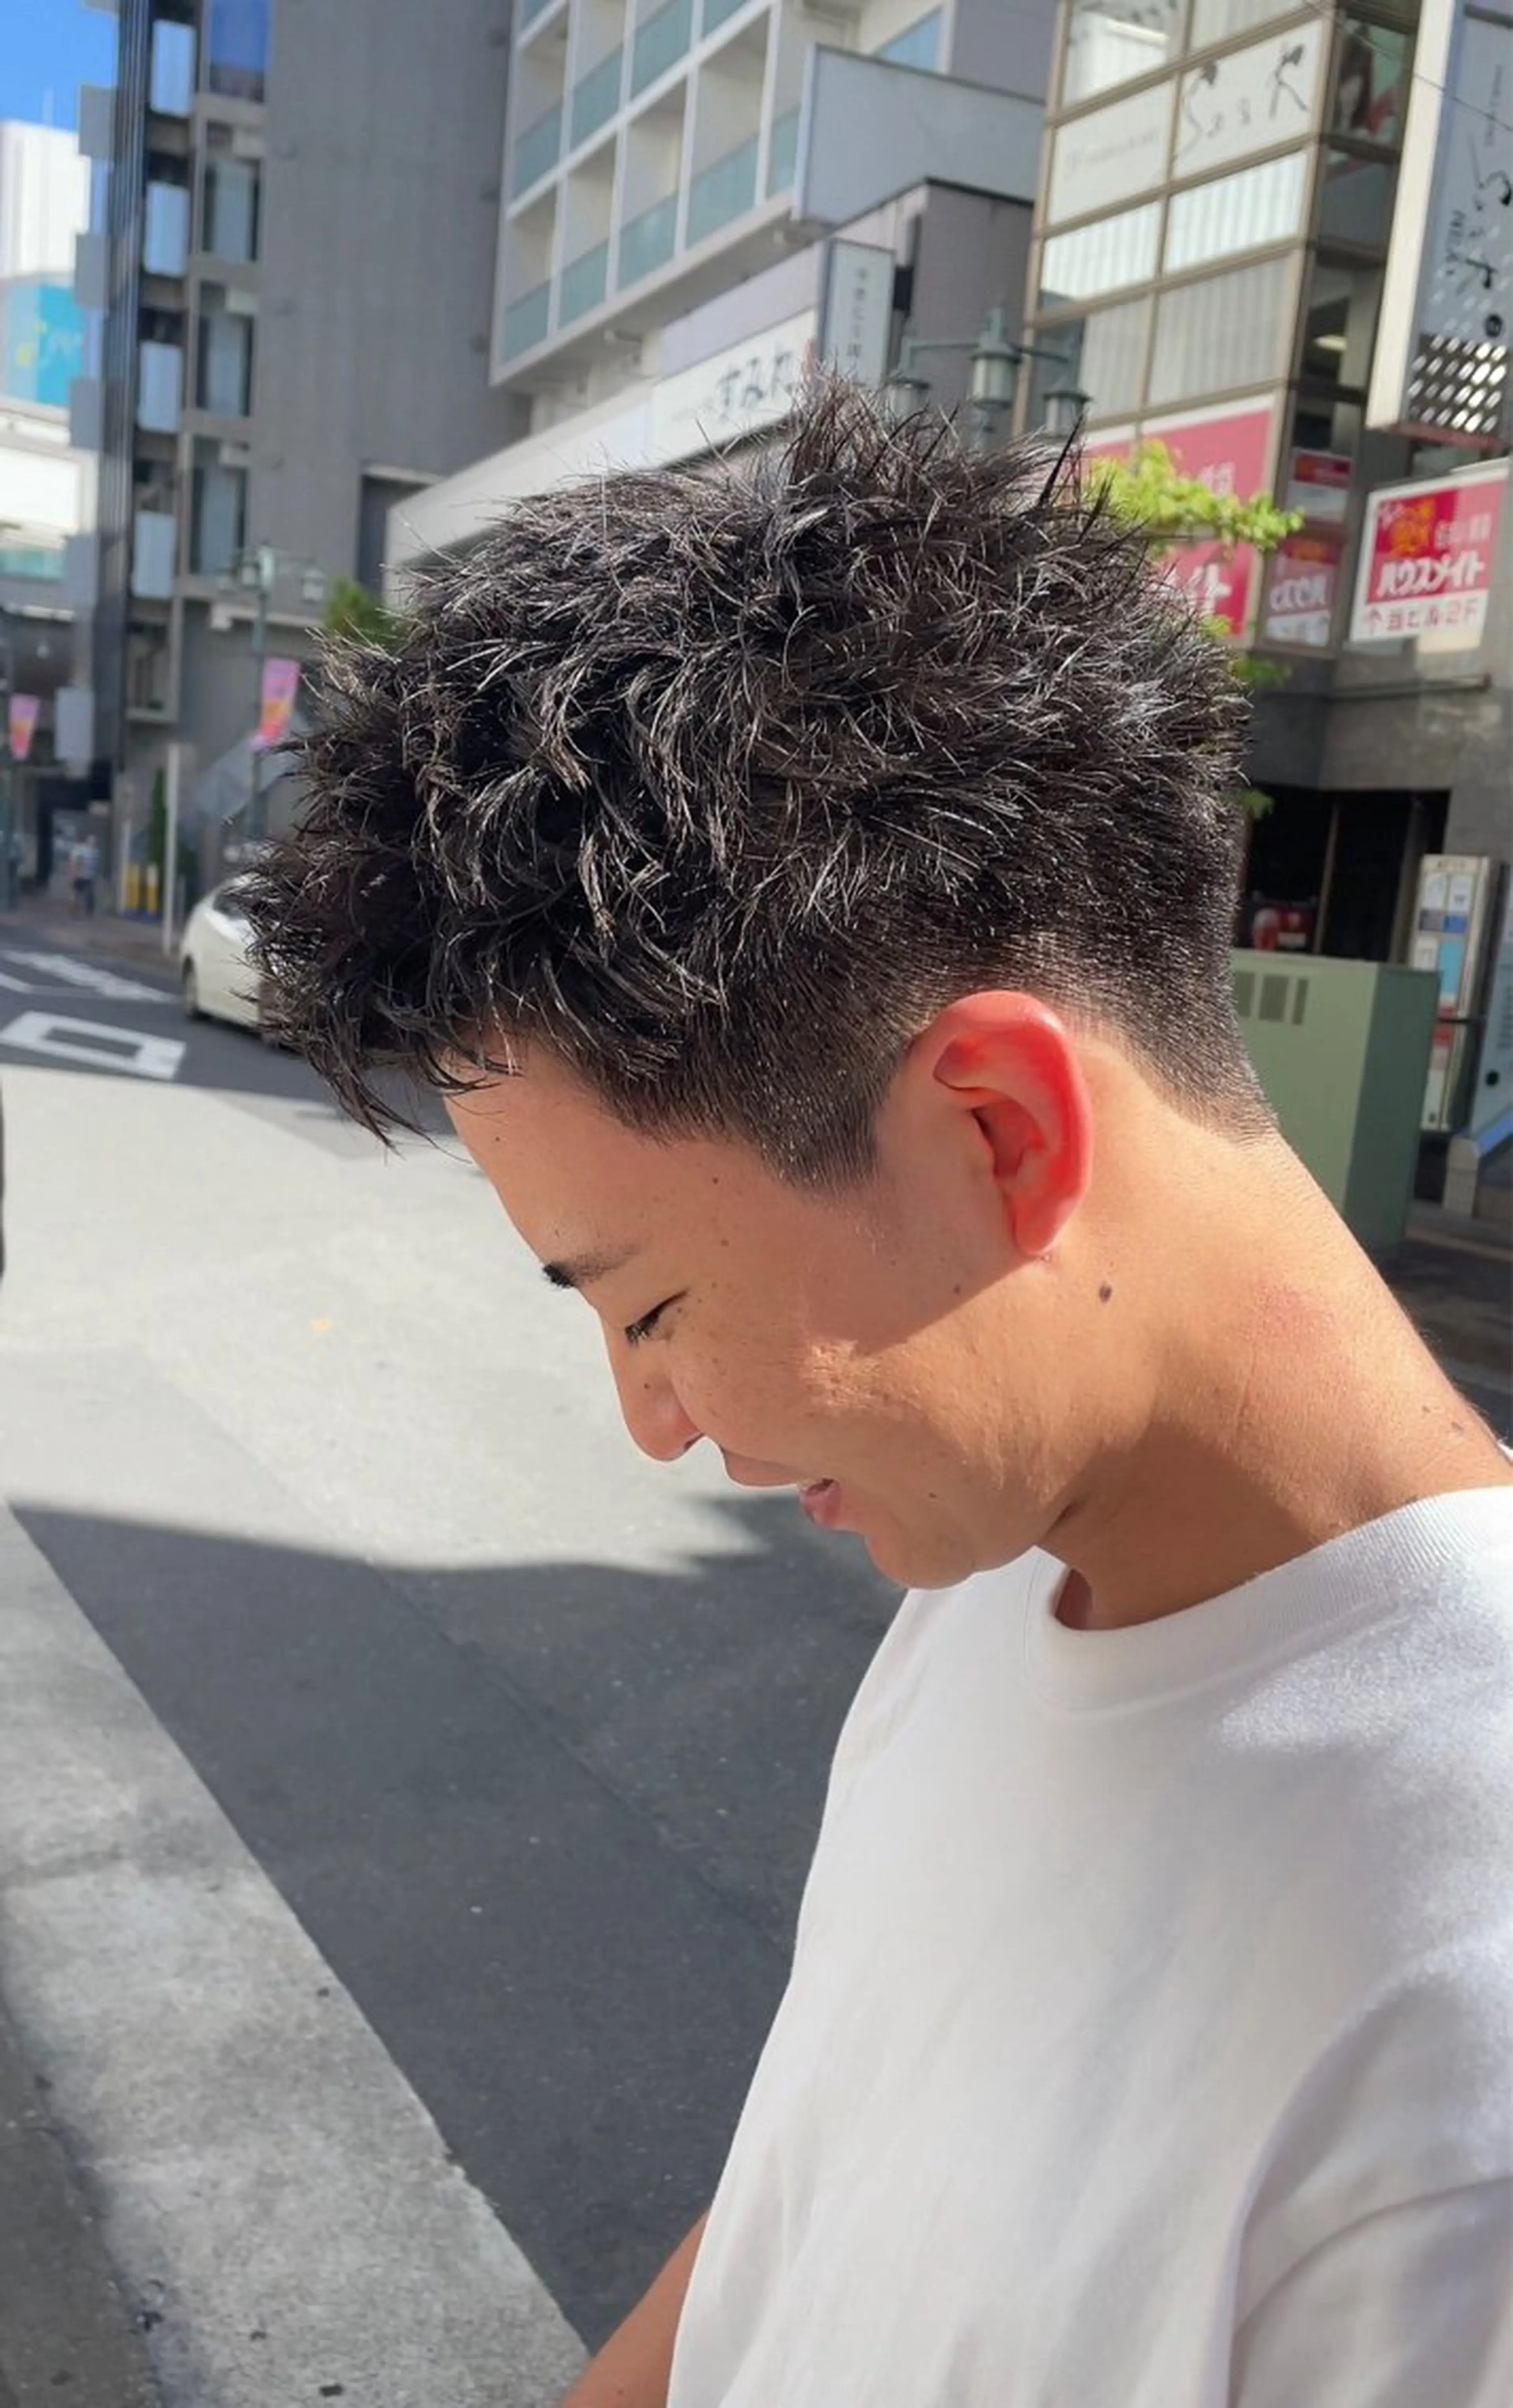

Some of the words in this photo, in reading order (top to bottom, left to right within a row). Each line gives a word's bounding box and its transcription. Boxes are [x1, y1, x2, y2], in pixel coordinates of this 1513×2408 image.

[1376, 550, 1485, 598] ハウスメイト
